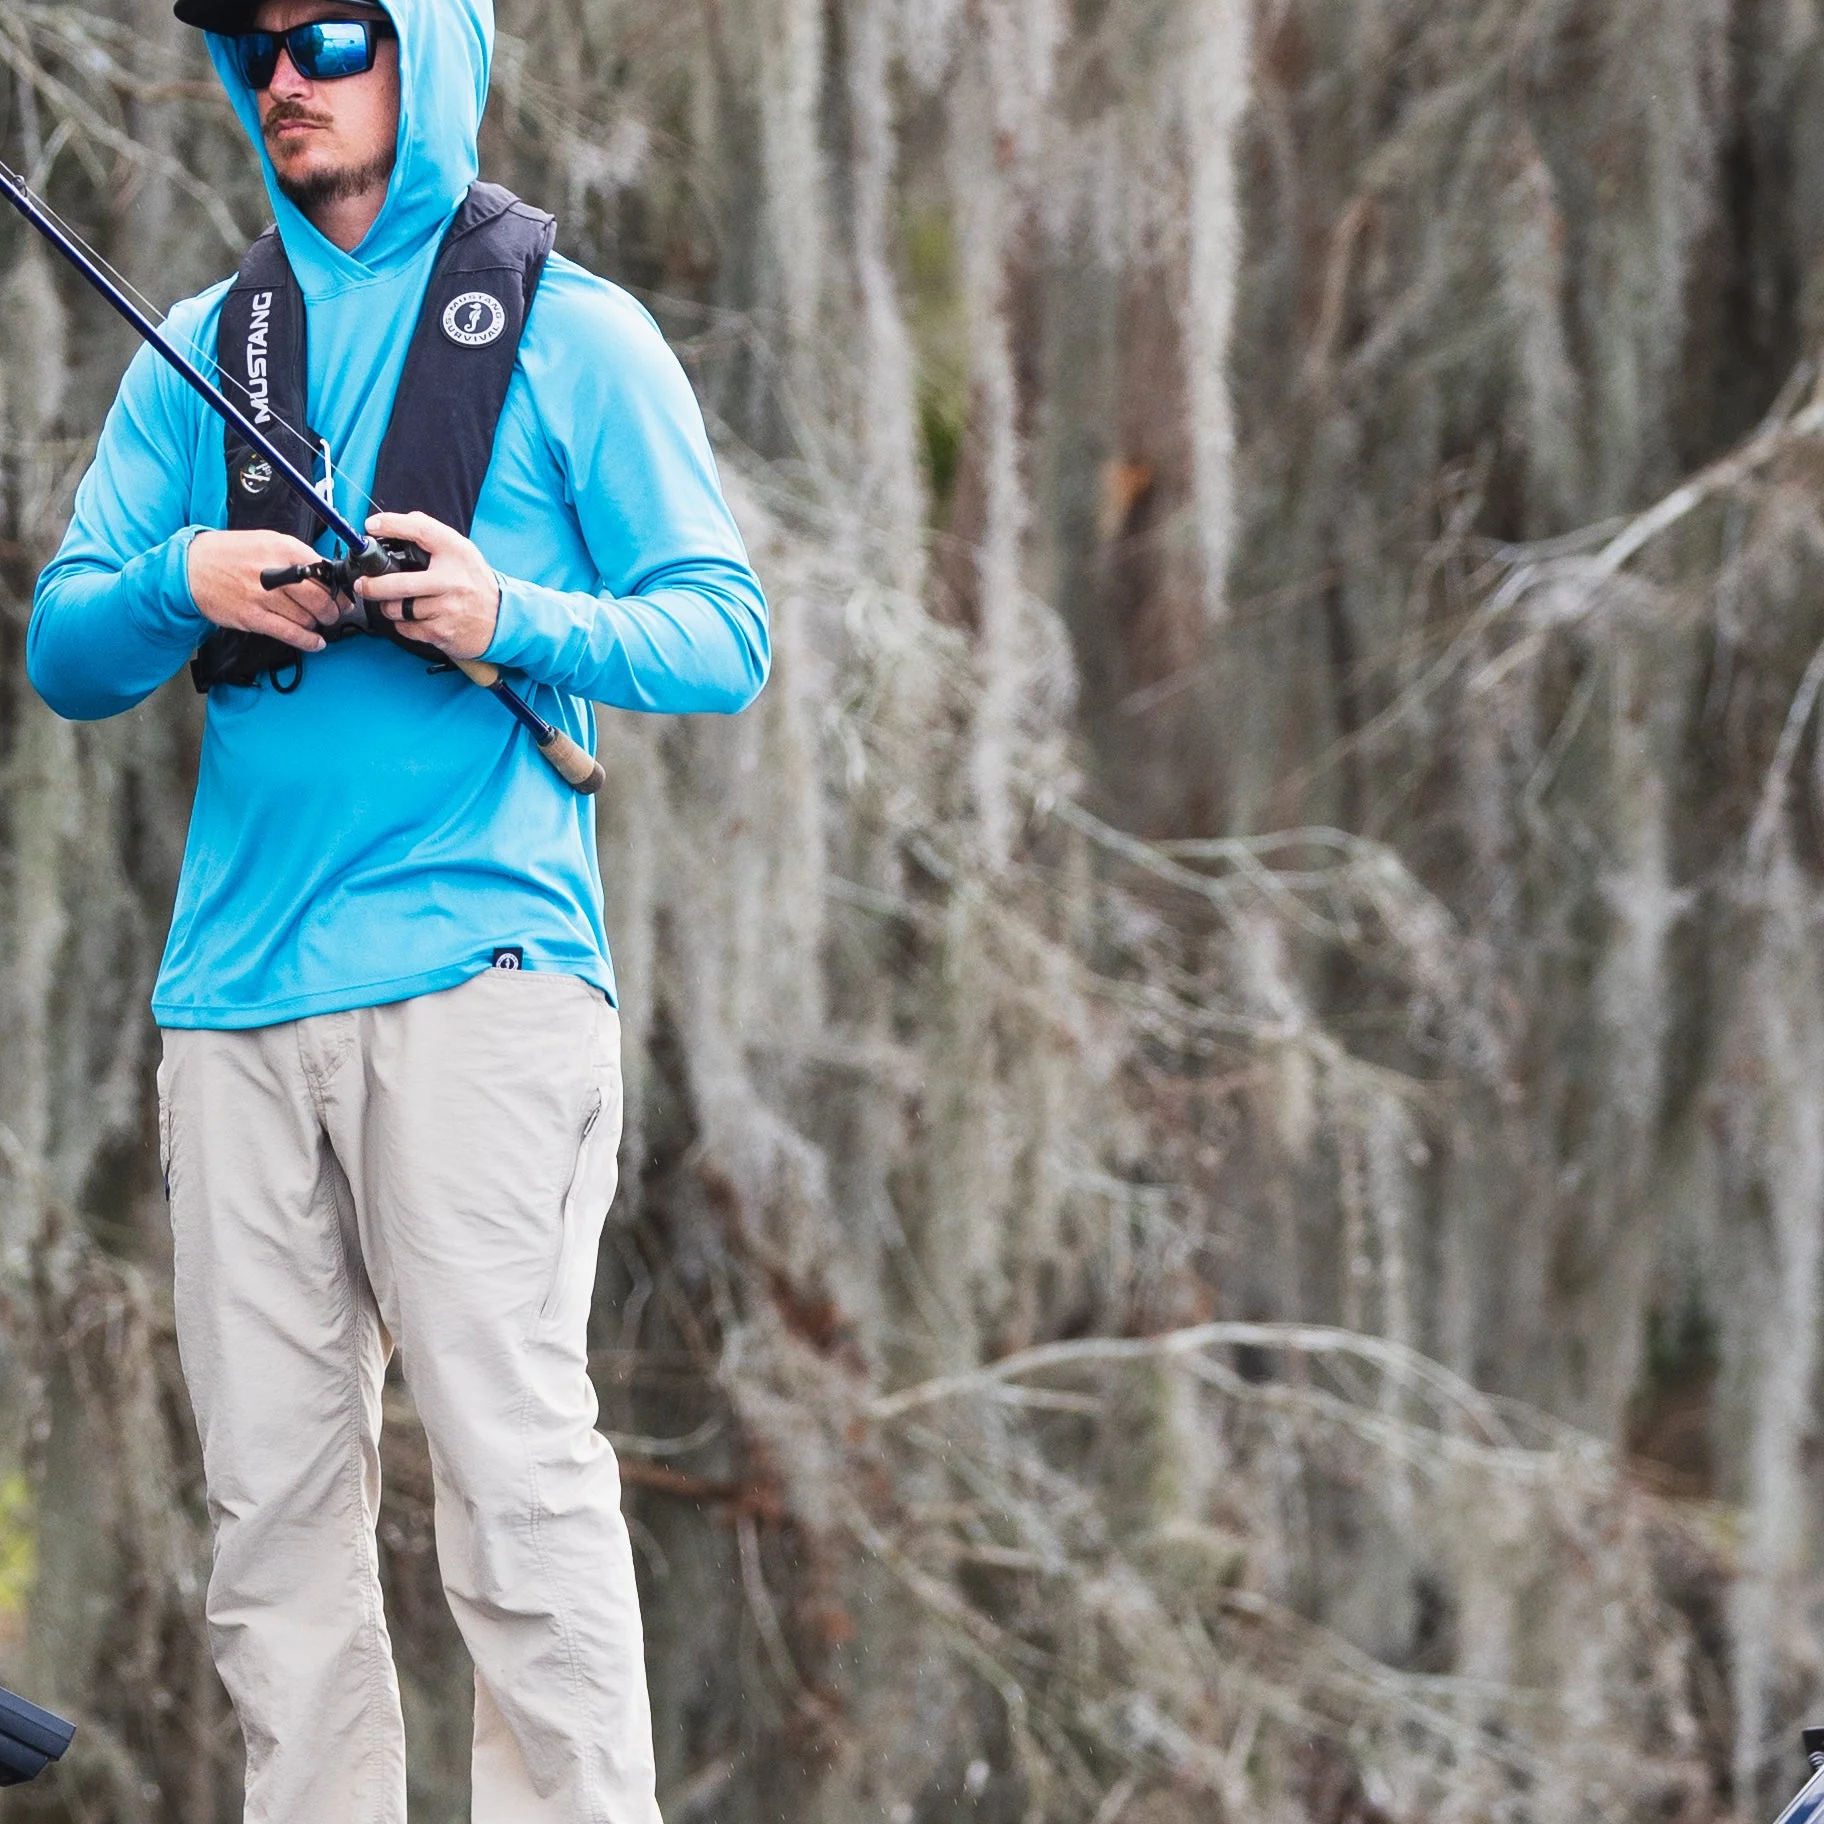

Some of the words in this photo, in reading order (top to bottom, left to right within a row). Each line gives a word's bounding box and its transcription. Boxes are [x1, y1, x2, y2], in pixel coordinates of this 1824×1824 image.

[449, 295, 502, 319] MUSTANG
[445, 317, 500, 342] SURVIVAL
[246, 291, 273, 425] MUSTANG
